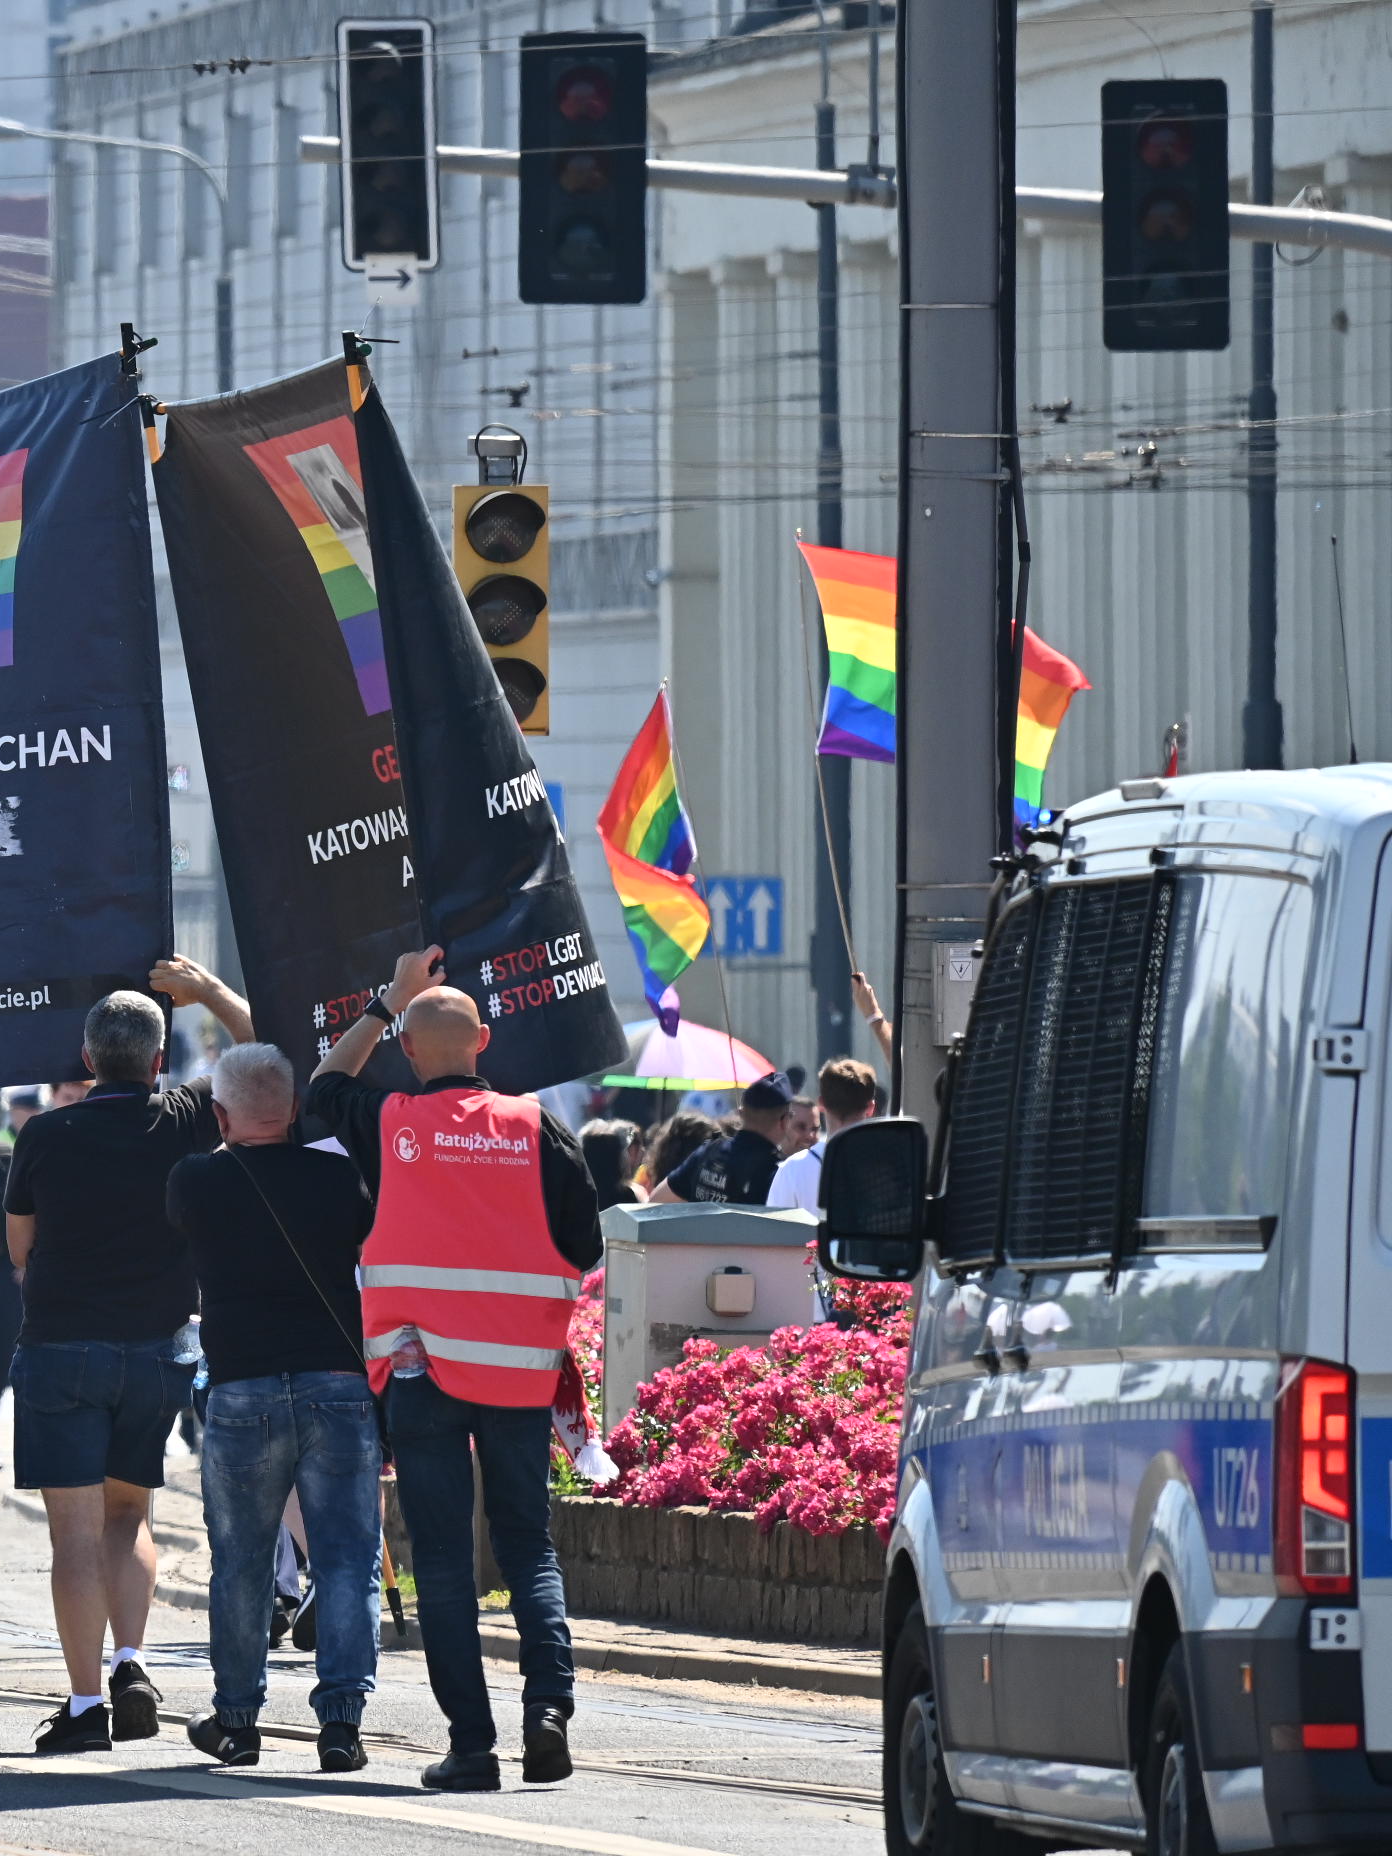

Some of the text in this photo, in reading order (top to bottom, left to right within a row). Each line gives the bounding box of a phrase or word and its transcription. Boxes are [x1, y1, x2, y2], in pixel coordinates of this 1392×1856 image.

[480, 932, 583, 986] #STOPLGBT
[433, 1153, 471, 1164] FUNDACJA
[434, 1131, 529, 1154] RatujŻycie.pl
[1023, 1443, 1090, 1538] POLICJA
[1213, 1446, 1261, 1529] U726
